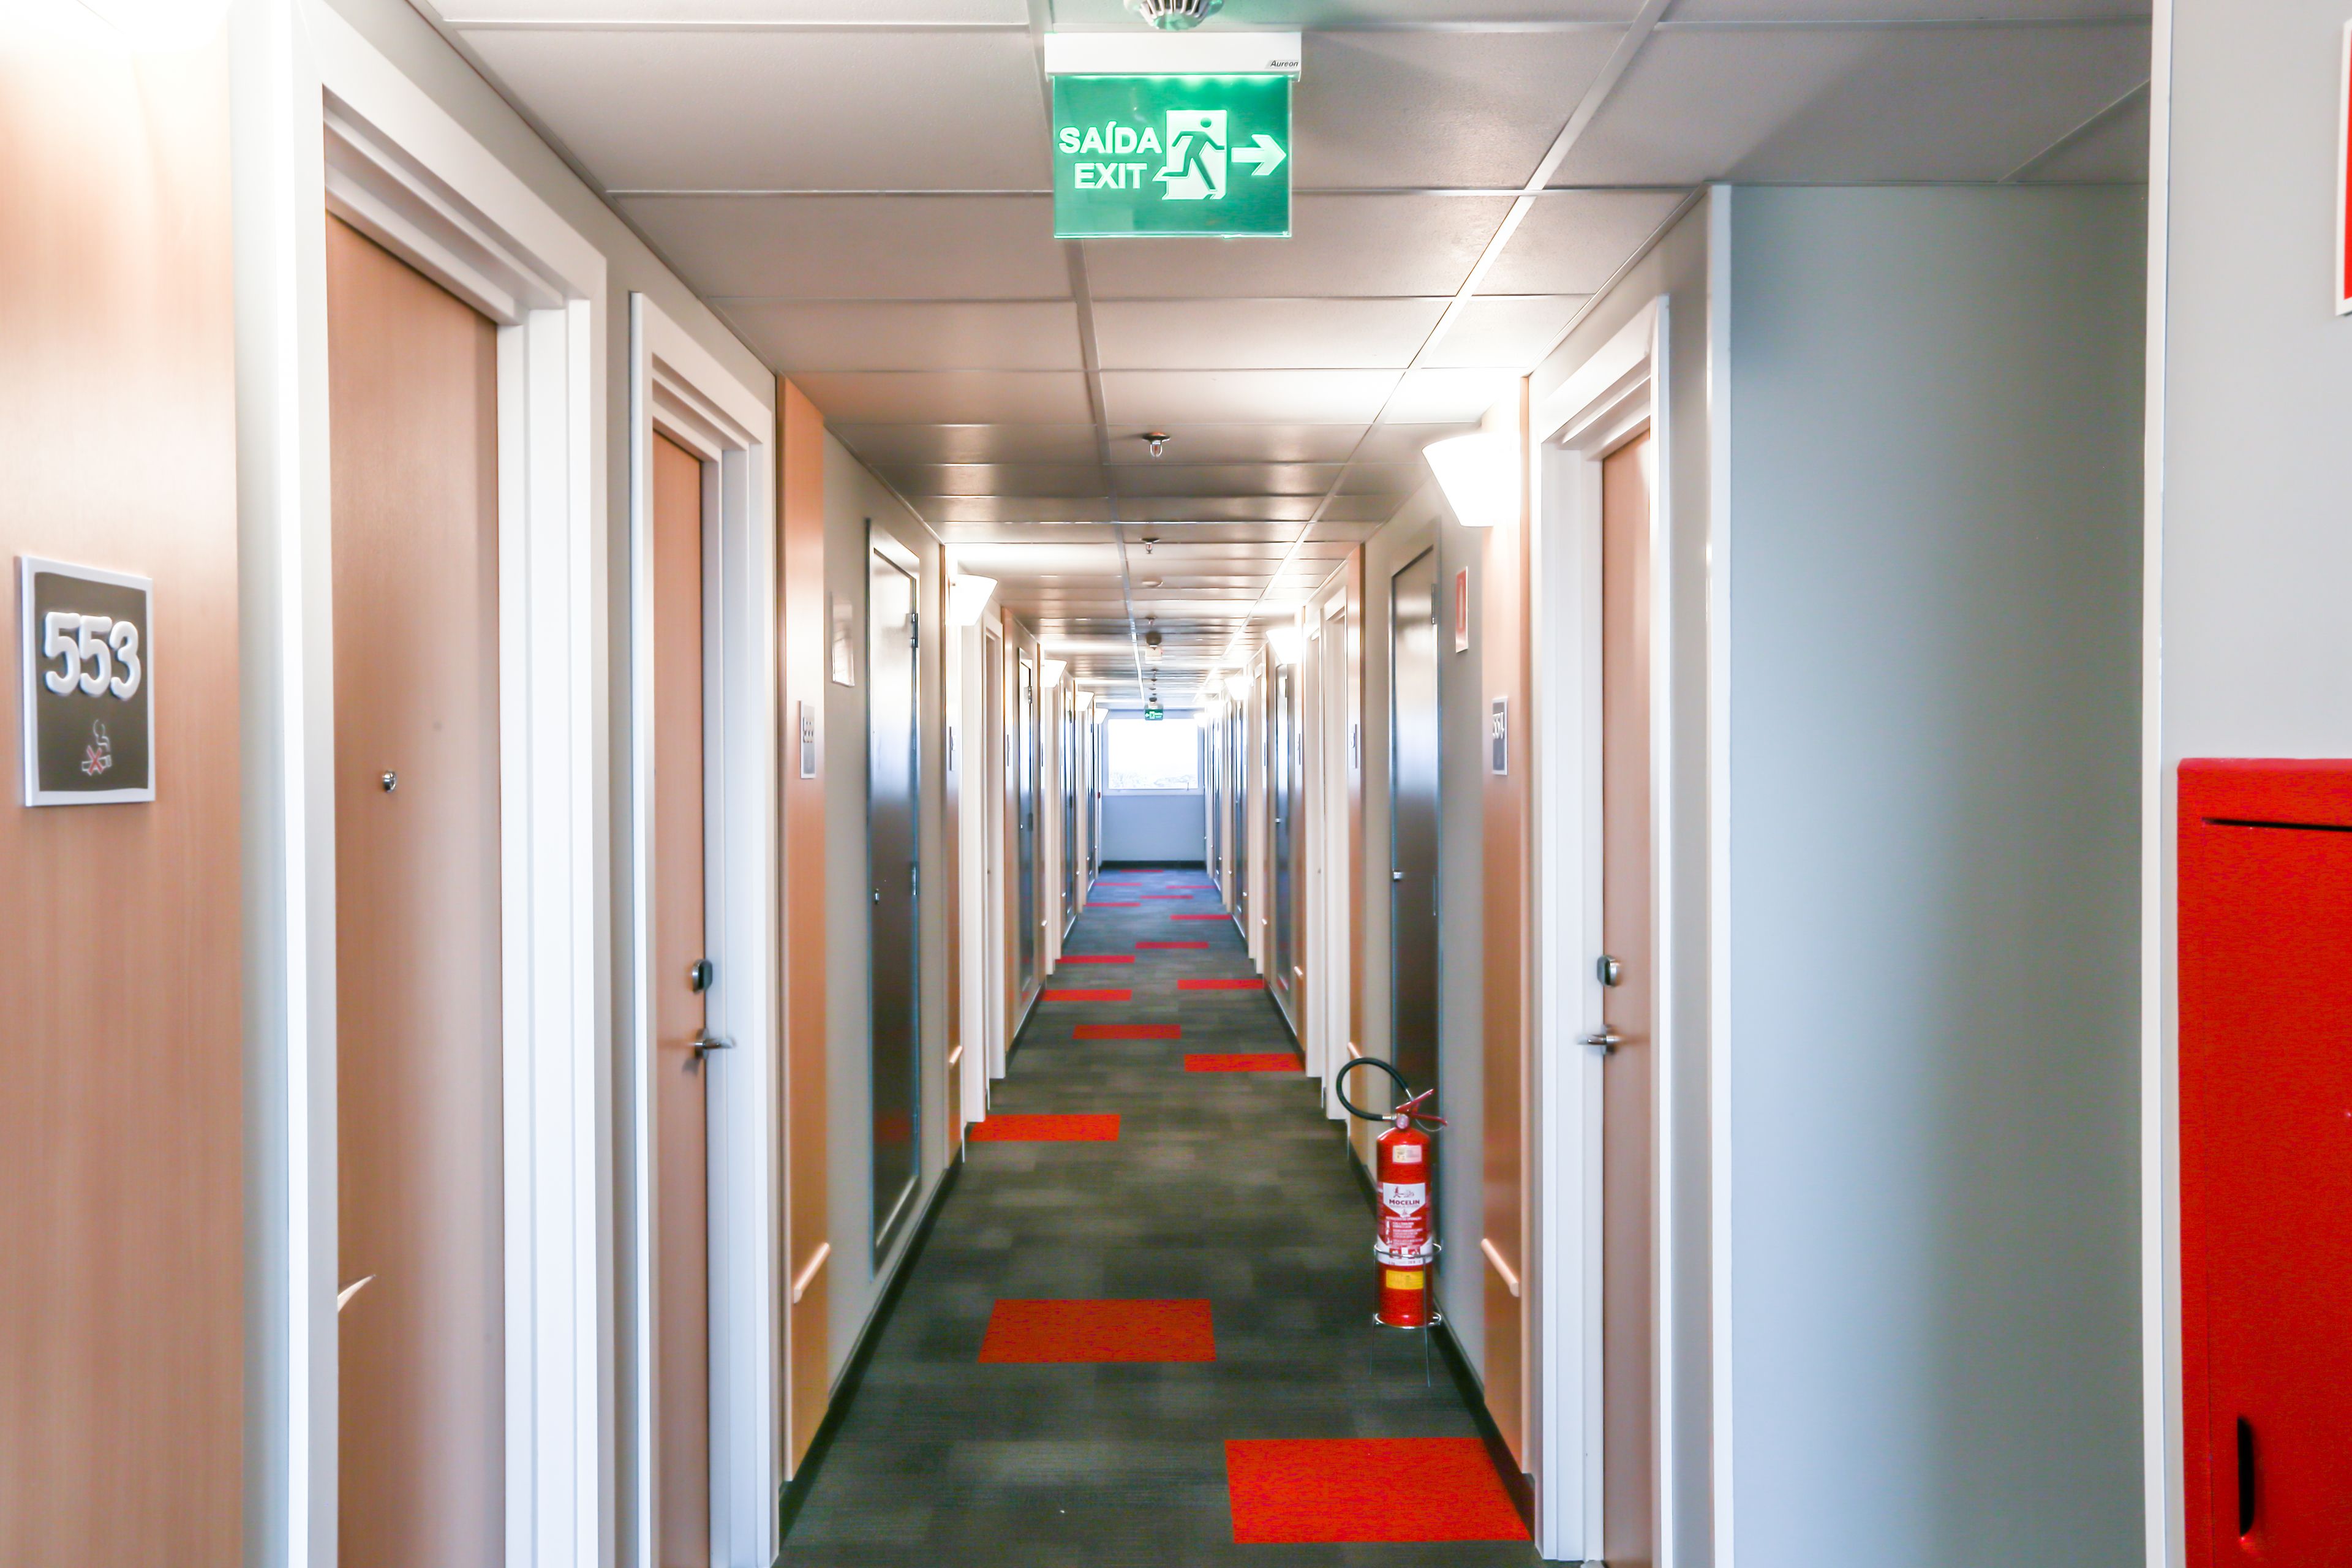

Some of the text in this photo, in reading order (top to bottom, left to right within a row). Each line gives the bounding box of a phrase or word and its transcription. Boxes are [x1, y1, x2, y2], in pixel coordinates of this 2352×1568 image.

[1059, 121, 1163, 154] SAÍDA
[1074, 162, 1147, 189] EXIT
[45, 611, 141, 700] 553
